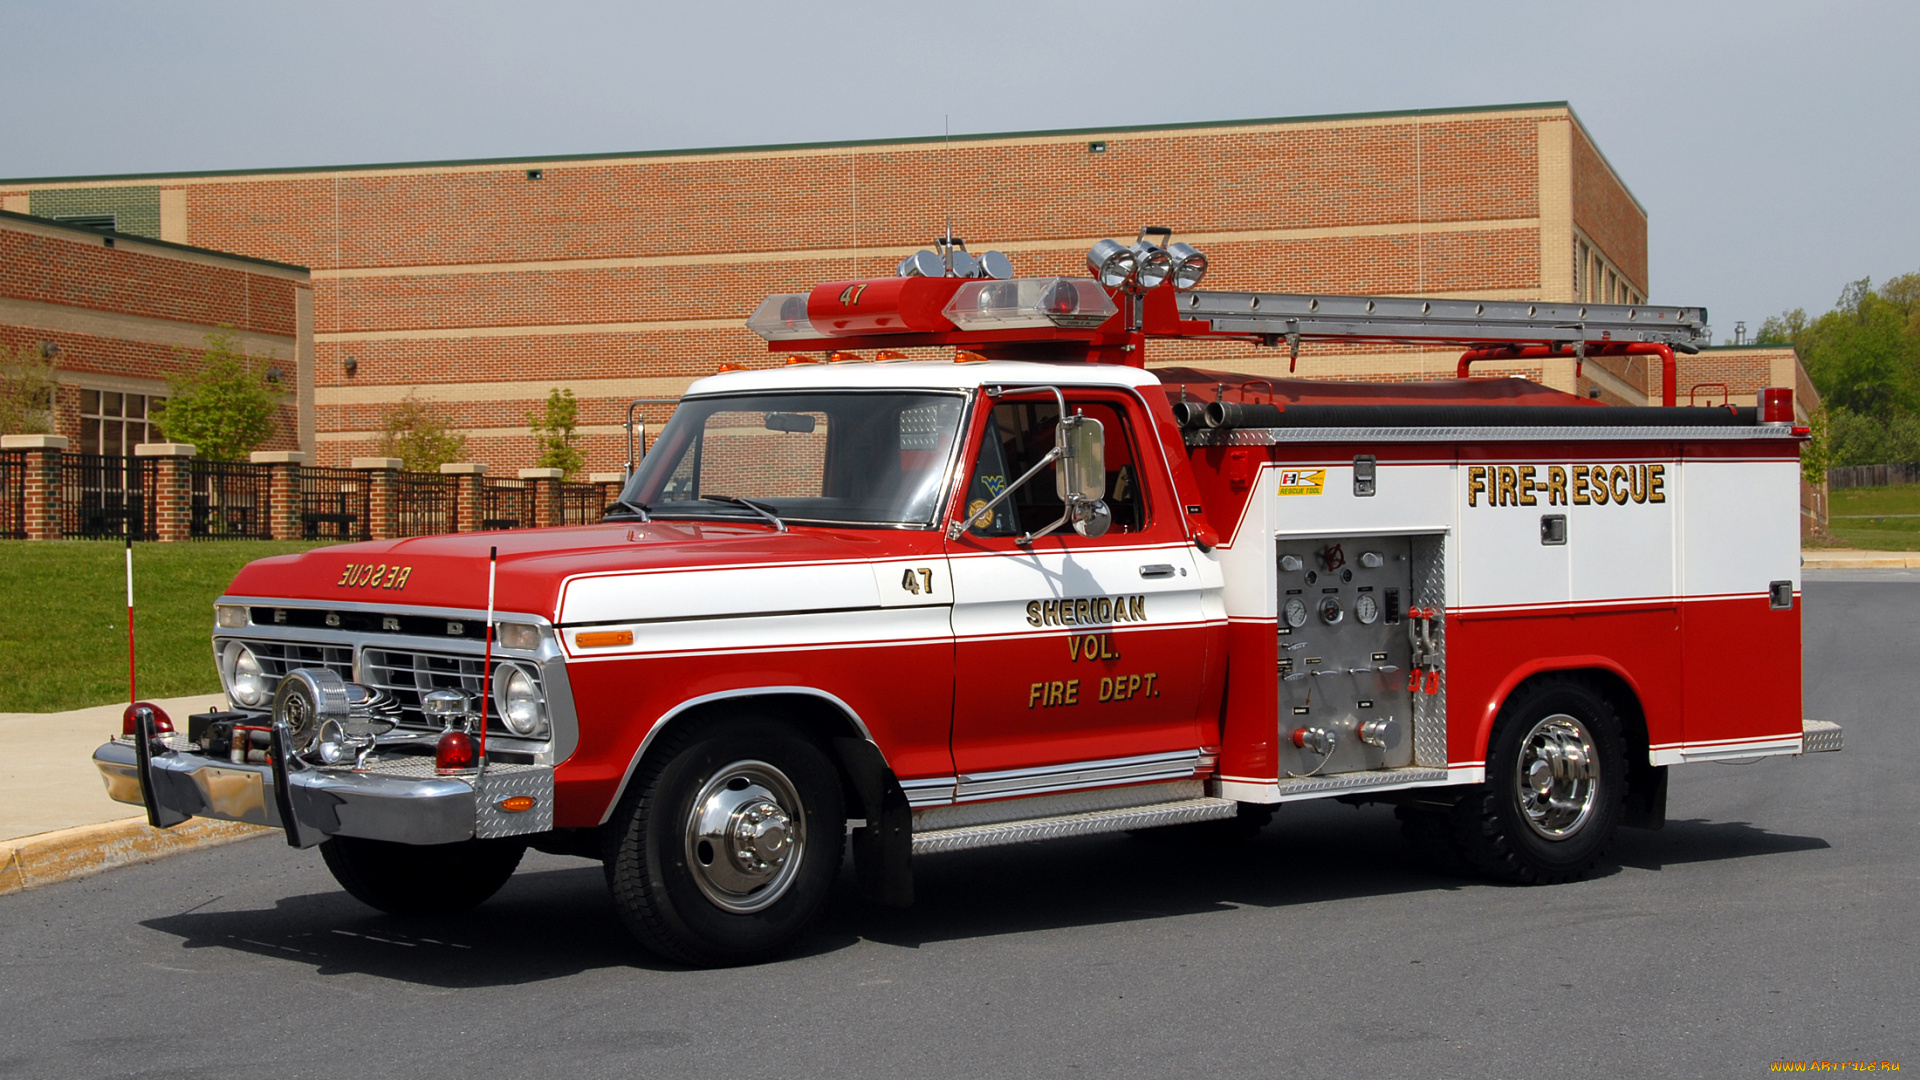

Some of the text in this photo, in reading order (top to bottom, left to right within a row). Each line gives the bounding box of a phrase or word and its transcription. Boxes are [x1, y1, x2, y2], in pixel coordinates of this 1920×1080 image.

[839, 284, 869, 307] 47
[1468, 465, 1665, 507] FIRE-RESCUE
[902, 568, 933, 595] 47
[274, 610, 464, 635] FORD
[1026, 595, 1147, 628] SHERIDAN
[1067, 634, 1121, 663] VOL.
[1028, 672, 1160, 709] FIRE DEPT.
